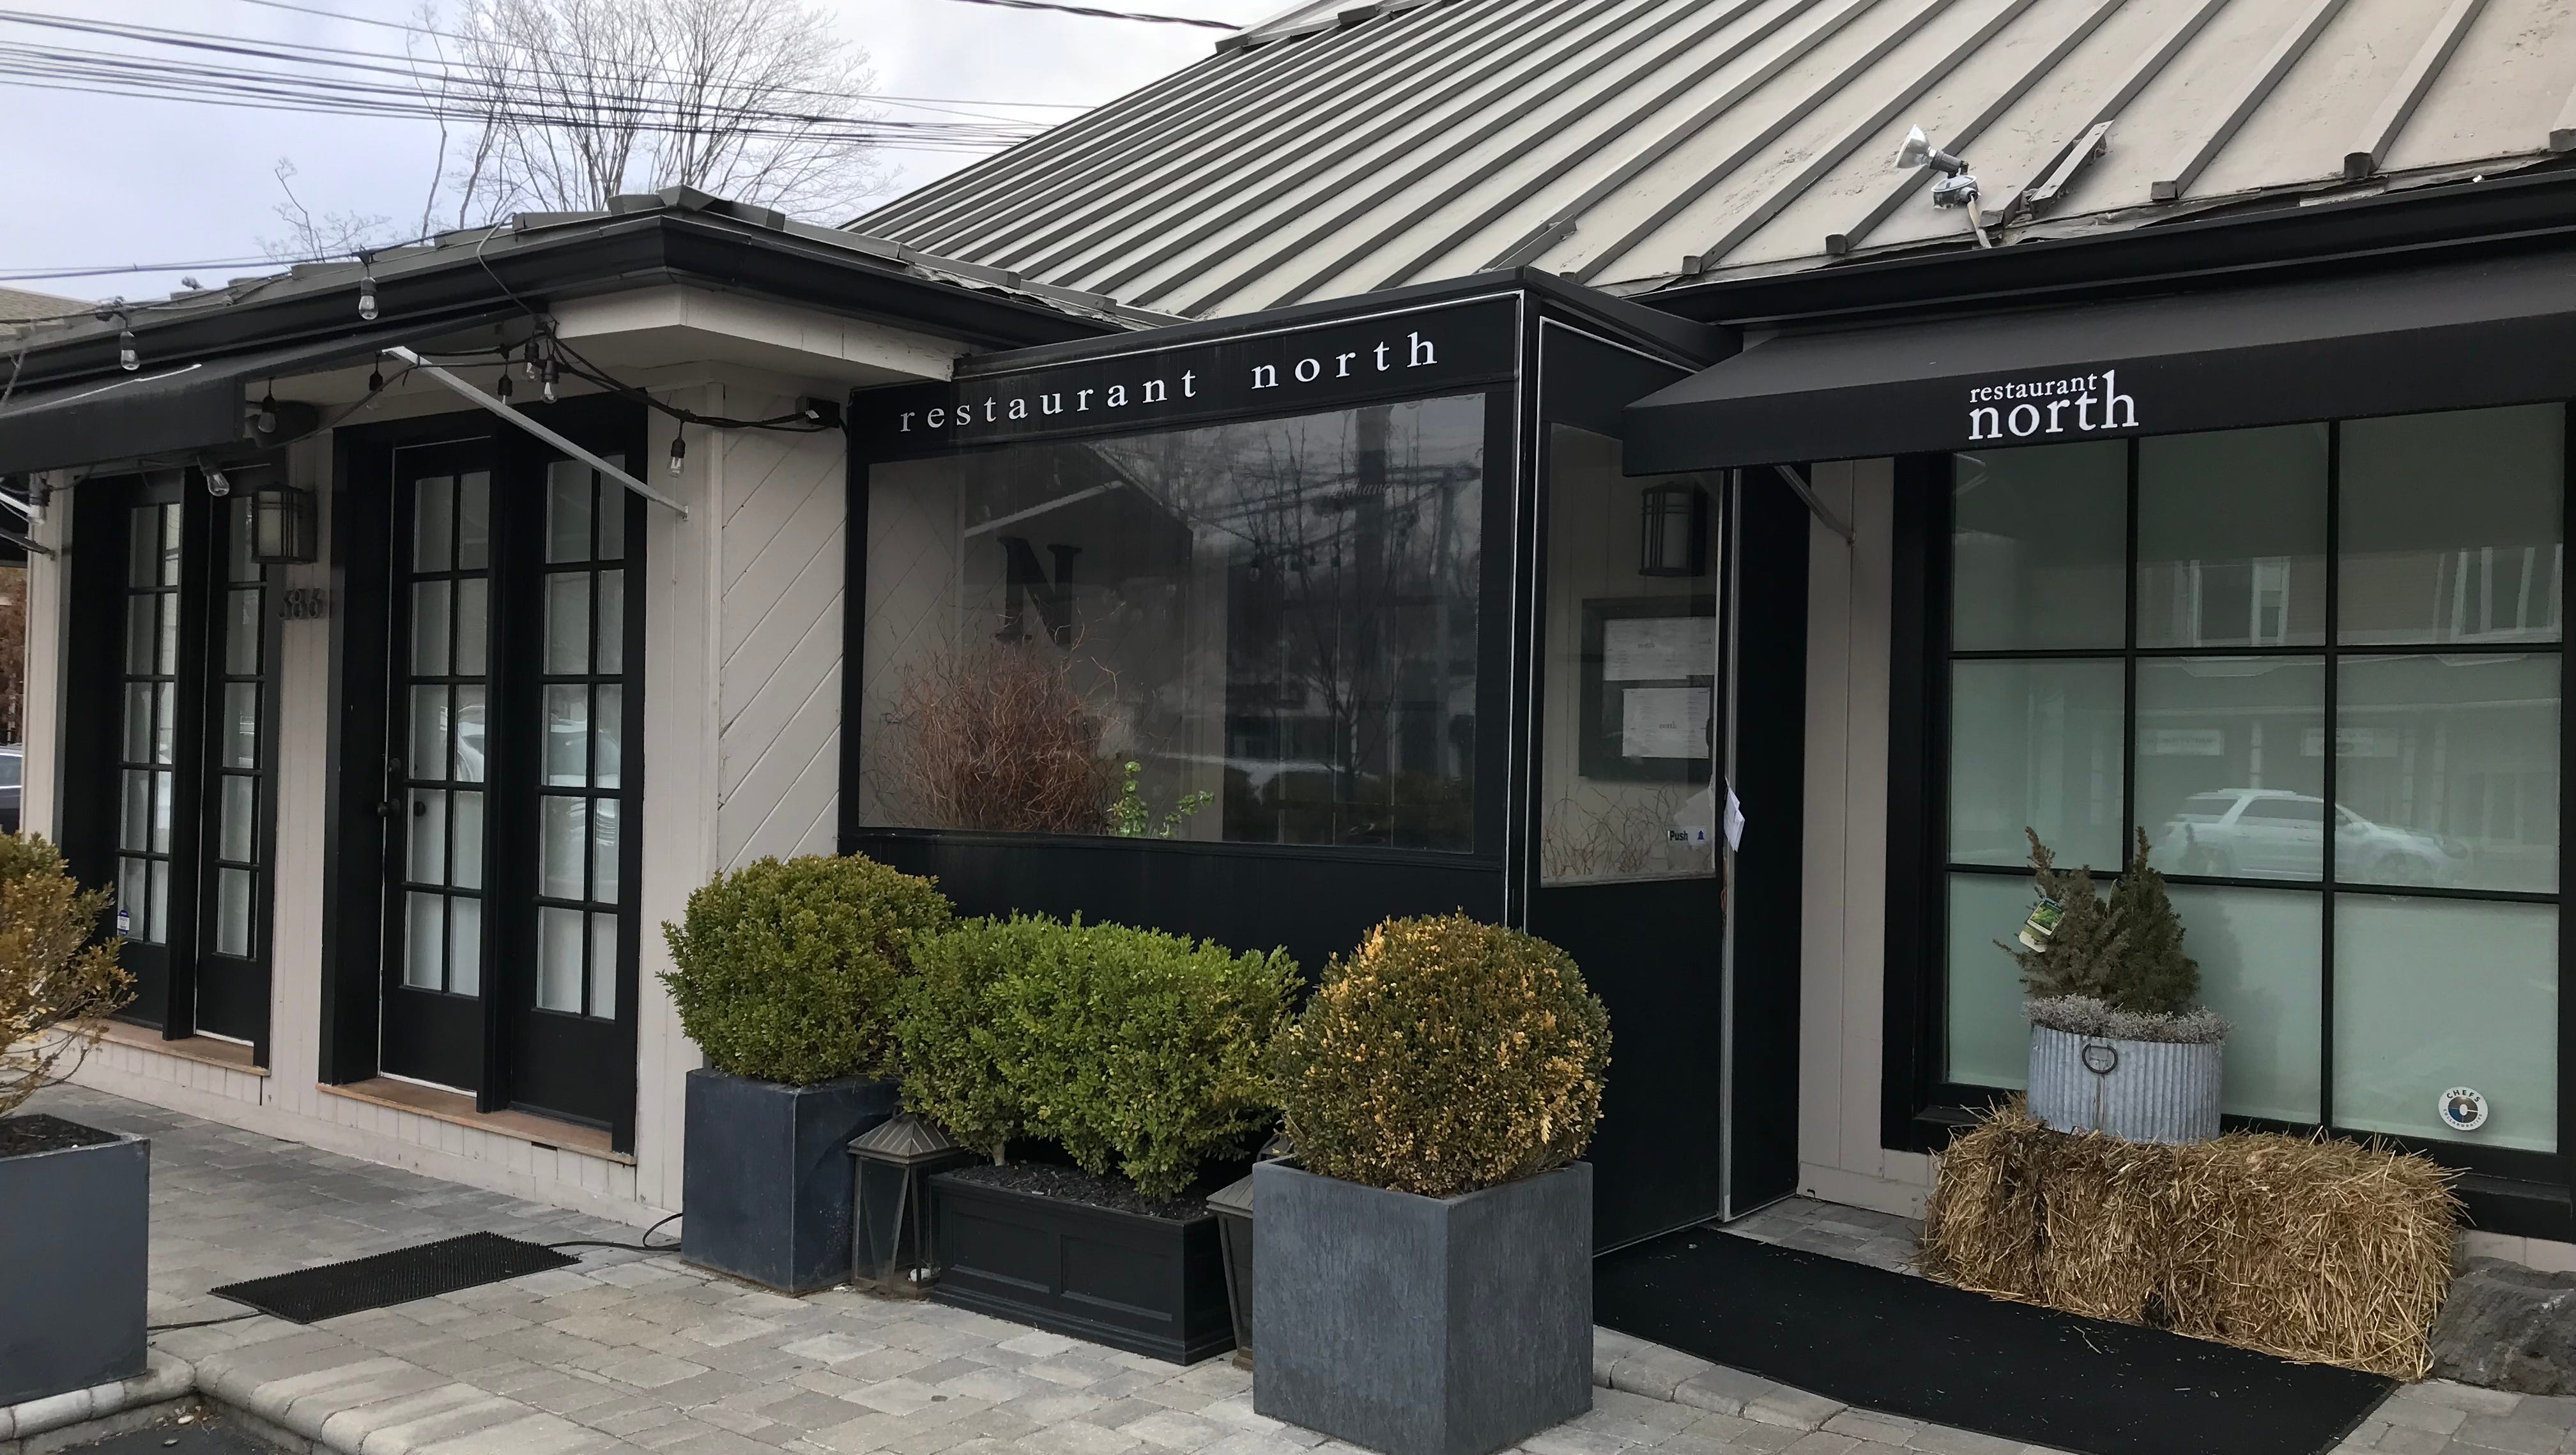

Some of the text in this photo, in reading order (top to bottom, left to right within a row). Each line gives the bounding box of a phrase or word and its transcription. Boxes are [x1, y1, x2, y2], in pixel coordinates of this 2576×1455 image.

[900, 331, 1438, 432] restaurant north
[1969, 373, 2098, 403] restaurant
[1968, 369, 2140, 440] north
[1669, 830, 1689, 841] Push
[2447, 1090, 2480, 1102] CHEFS
